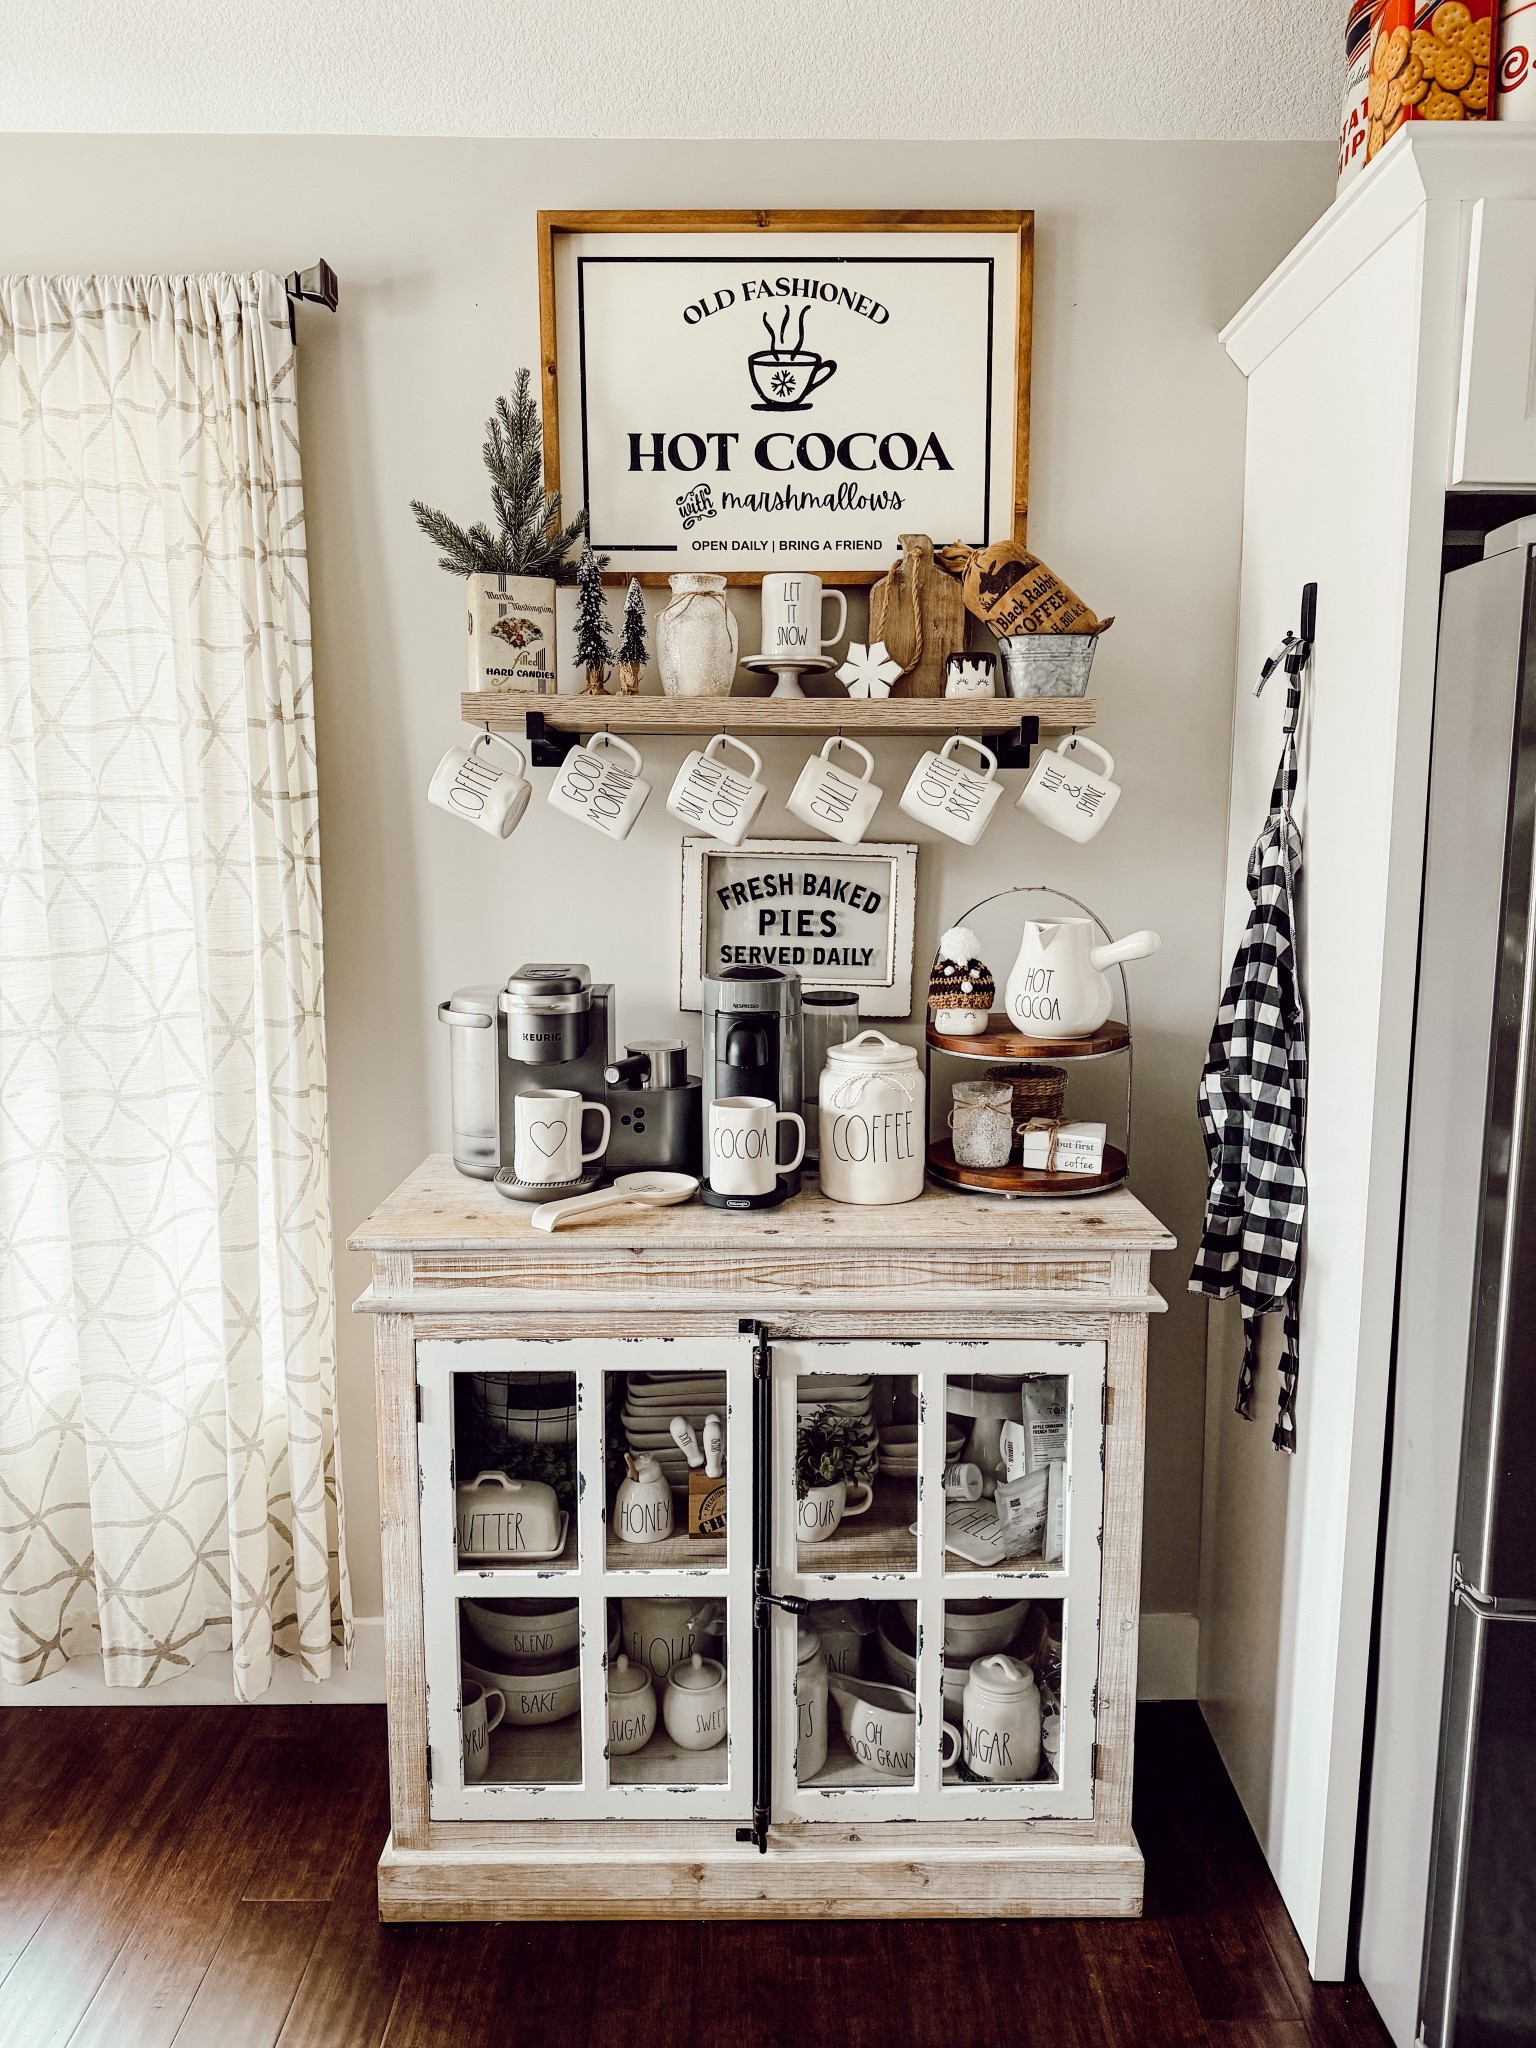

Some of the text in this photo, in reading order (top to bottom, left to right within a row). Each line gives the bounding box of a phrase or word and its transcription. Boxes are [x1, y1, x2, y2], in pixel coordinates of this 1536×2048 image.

[683, 277, 890, 325] OLD FASHIONED
[627, 431, 954, 472] HOT COCOA
[677, 481, 905, 526] with marshmallows
[692, 540, 883, 551] OPEN DAILY BRING A FRIEND
[485, 591, 514, 601] Martha
[783, 582, 801, 602] LET
[995, 573, 1059, 632] Black Rabbit
[787, 604, 797, 623] IT
[1014, 590, 1069, 634] COFFEE
[777, 626, 808, 646] SNOW
[486, 668, 555, 679] HARD CANDIES
[448, 757, 503, 820] COFFEE
[561, 754, 604, 803] GOOD
[676, 756, 727, 820] BUT FIRST
[917, 758, 960, 806] COFFEE
[1040, 767, 1066, 792] RISE
[1063, 783, 1082, 798] &
[586, 763, 637, 831] MORNING
[709, 776, 752, 826] COFFEE
[810, 771, 858, 823] GULP
[945, 774, 989, 821] BREAK
[1076, 784, 1106, 817] SHINE
[716, 872, 882, 914] FRESH BAKED
[759, 909, 837, 937] PIES
[720, 945, 874, 966] SERVED DAILY
[1025, 967, 1055, 993] HOT
[1015, 994, 1061, 1020] COCOA
[522, 1033, 562, 1042] KEURIG
[713, 1127, 770, 1159] COCOA
[833, 1111, 914, 1163] COFFEE
[1056, 1138, 1094, 1151] but first
[1064, 1157, 1094, 1170] coffee
[621, 1500, 671, 1535] HONEY
[798, 1499, 835, 1528] POUR
[513, 1633, 553, 1653] BLEND
[521, 1692, 558, 1715] BAKE
[464, 1721, 486, 1757] YRU
[609, 1714, 648, 1742] SUGAR
[865, 1721, 883, 1745] OH
[965, 1719, 1013, 1766] SUGAR
[849, 1735, 915, 1770] OOD GRAVY
